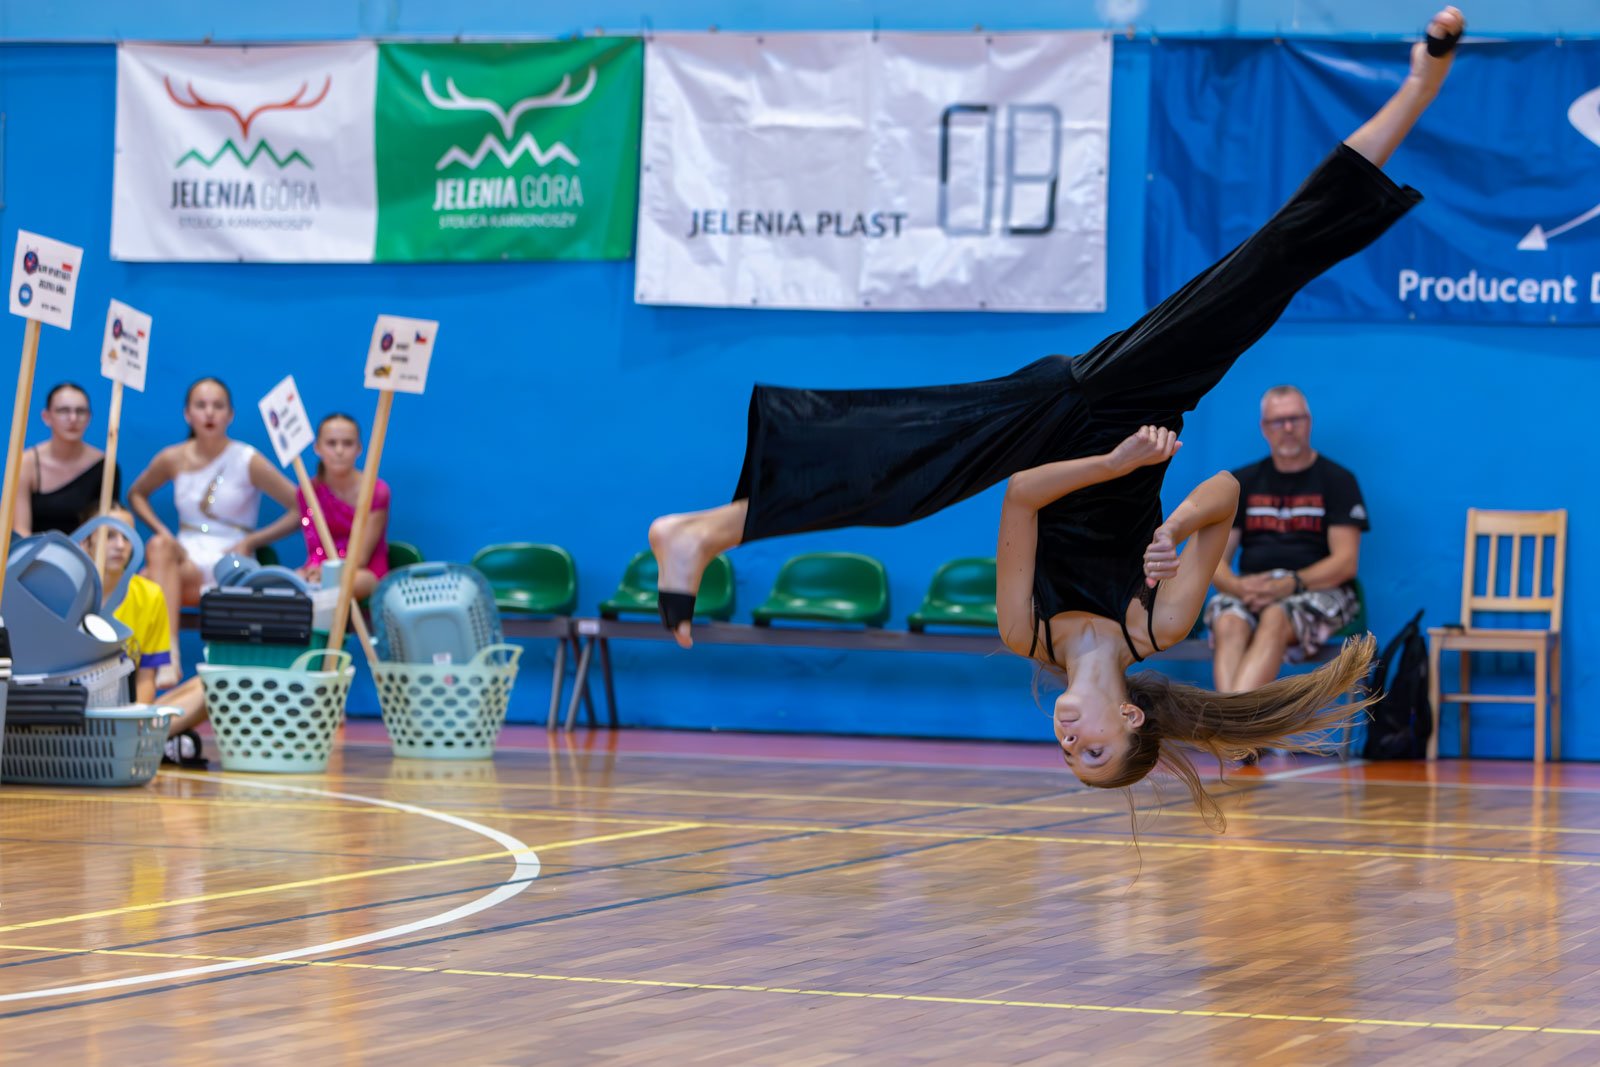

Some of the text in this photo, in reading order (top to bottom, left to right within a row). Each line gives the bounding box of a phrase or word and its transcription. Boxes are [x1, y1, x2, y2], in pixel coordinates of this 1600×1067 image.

[171, 179, 256, 209] JELENIA
[432, 177, 519, 211] JELENIA
[687, 209, 908, 238] JELENIA PLAST
[1399, 269, 1578, 304] Producent
